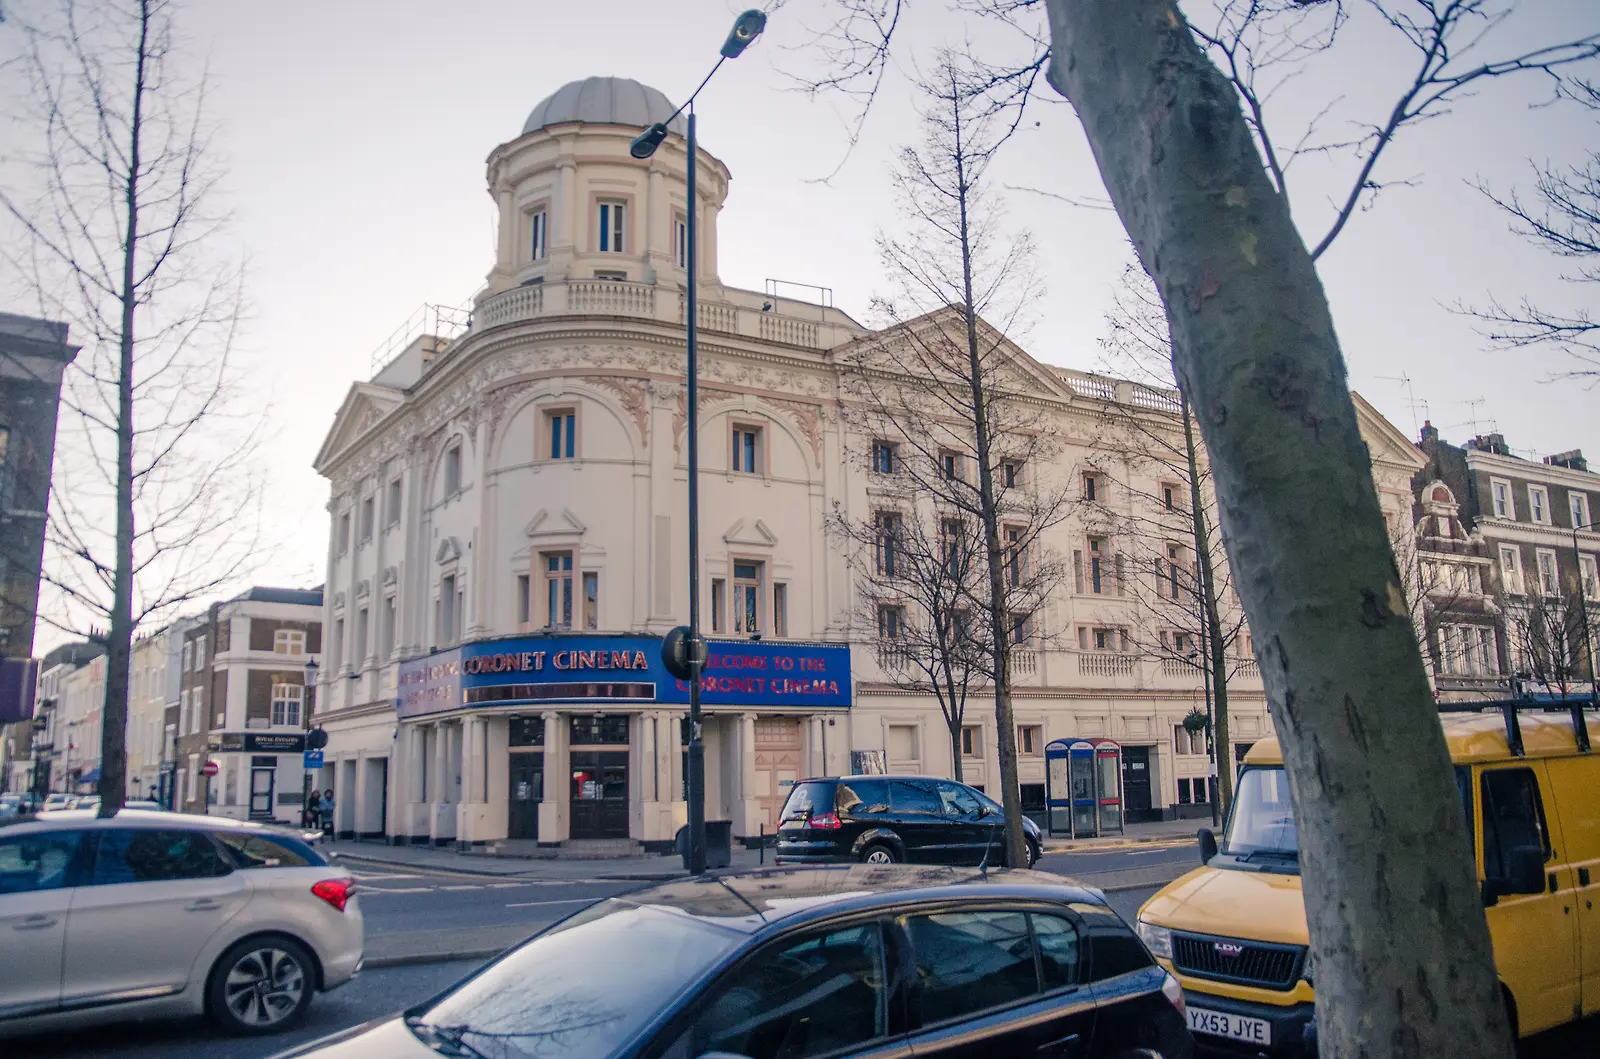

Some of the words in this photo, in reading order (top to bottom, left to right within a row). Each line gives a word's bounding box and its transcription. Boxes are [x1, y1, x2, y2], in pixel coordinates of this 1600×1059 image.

[461, 651, 546, 674] CORONET
[552, 650, 648, 671] CINEMA
[706, 653, 768, 669] ELCOME
[773, 656, 794, 671] TO
[798, 657, 826, 671] THE
[771, 679, 840, 694] CINEMA
[1214, 942, 1243, 952] LDV
[1190, 1010, 1229, 1034] YX53
[1233, 1019, 1264, 1040] JYE
